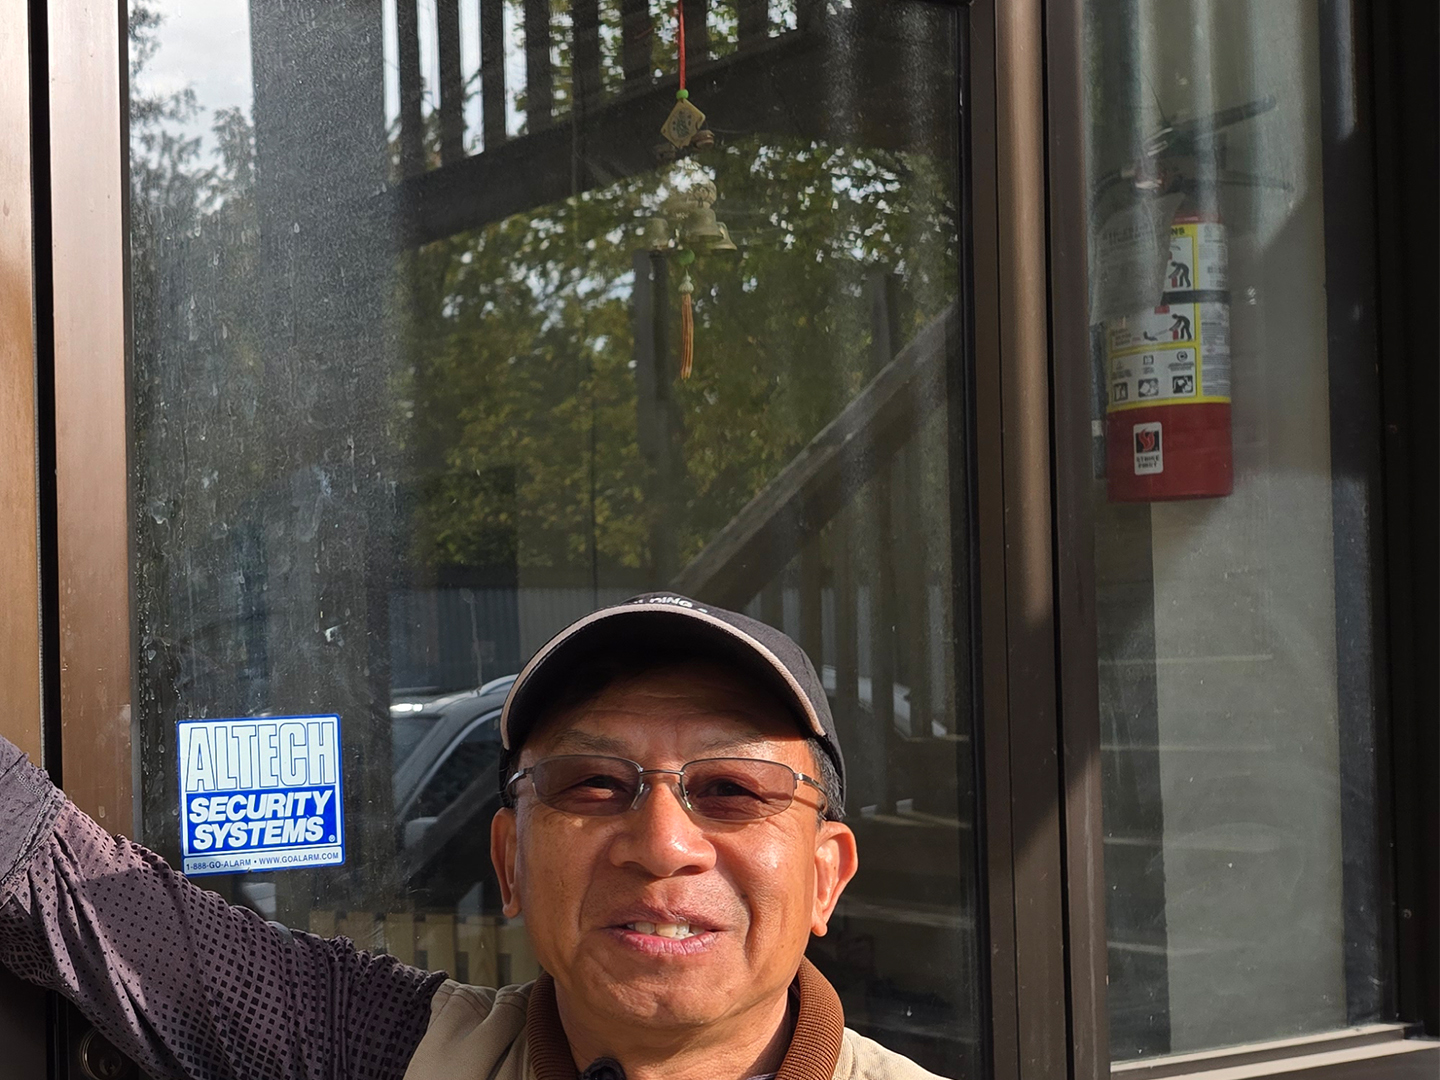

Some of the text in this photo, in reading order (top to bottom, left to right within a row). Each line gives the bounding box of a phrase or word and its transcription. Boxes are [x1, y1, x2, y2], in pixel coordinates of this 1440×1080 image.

[185, 722, 336, 792] ALTECH
[189, 790, 333, 823] SECURITY
[193, 816, 324, 850] SYSTEMS
[186, 852, 339, 871] 1-888-GO-ALARM WWW.GOALARM.COM
